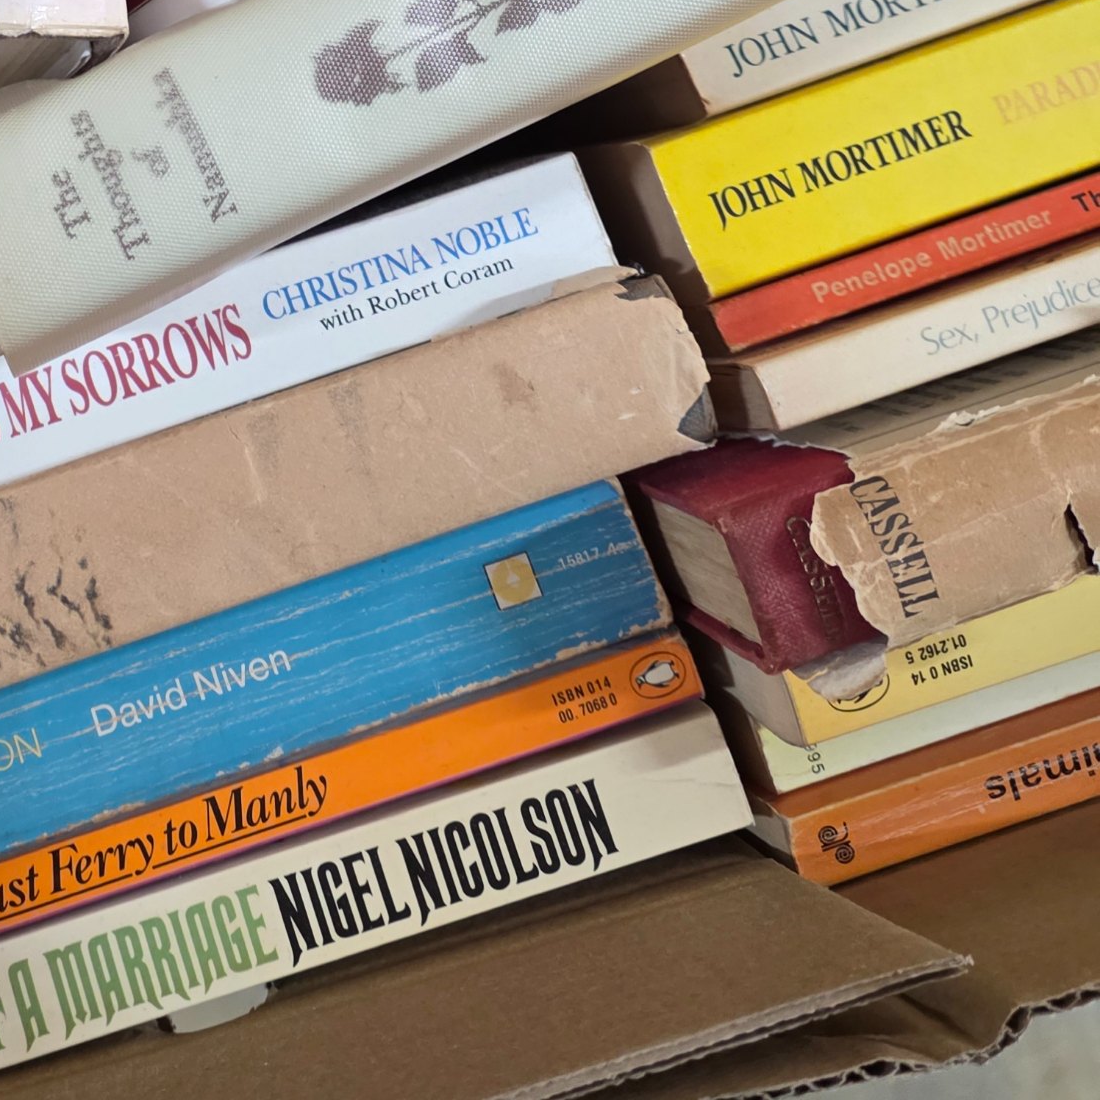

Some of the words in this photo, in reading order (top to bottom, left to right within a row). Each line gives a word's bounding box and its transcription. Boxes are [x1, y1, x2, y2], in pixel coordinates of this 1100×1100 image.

[724, 16, 820, 78] JOHN
[52, 166, 92, 239] The
[70, 109, 153, 262] Thoughts
[131, 146, 170, 180] of
[707, 167, 797, 231] JOHN
[796, 109, 975, 194] MORTIMER
[261, 237, 430, 322] CHRISTINA
[432, 206, 540, 272] NOBLE
[318, 304, 365, 332] with
[367, 276, 442, 315] Robert
[443, 255, 515, 291] Coram
[810, 248, 933, 305] Penelope
[936, 208, 1053, 262] Mortimer
[919, 321, 981, 358] Sex,
[982, 273, 1100, 334] Prejudice
[61, 303, 253, 416] SORROWS
[850, 475, 940, 620] CASSELL
[905, 650, 915, 665] 5
[919, 633, 968, 662] 01.2162
[942, 654, 974, 673] ISBN
[89, 677, 188, 738] David
[192, 648, 292, 702] Niven
[551, 684, 585, 707] ISBN
[48, 831, 156, 895] Ferry
[163, 816, 199, 854] to
[202, 765, 329, 843] Manly
[6, 958, 50, 1053] A
[41, 883, 280, 1041] MARRIAGE
[268, 846, 412, 968] NIGEL
[394, 777, 620, 927] NICOLSON
